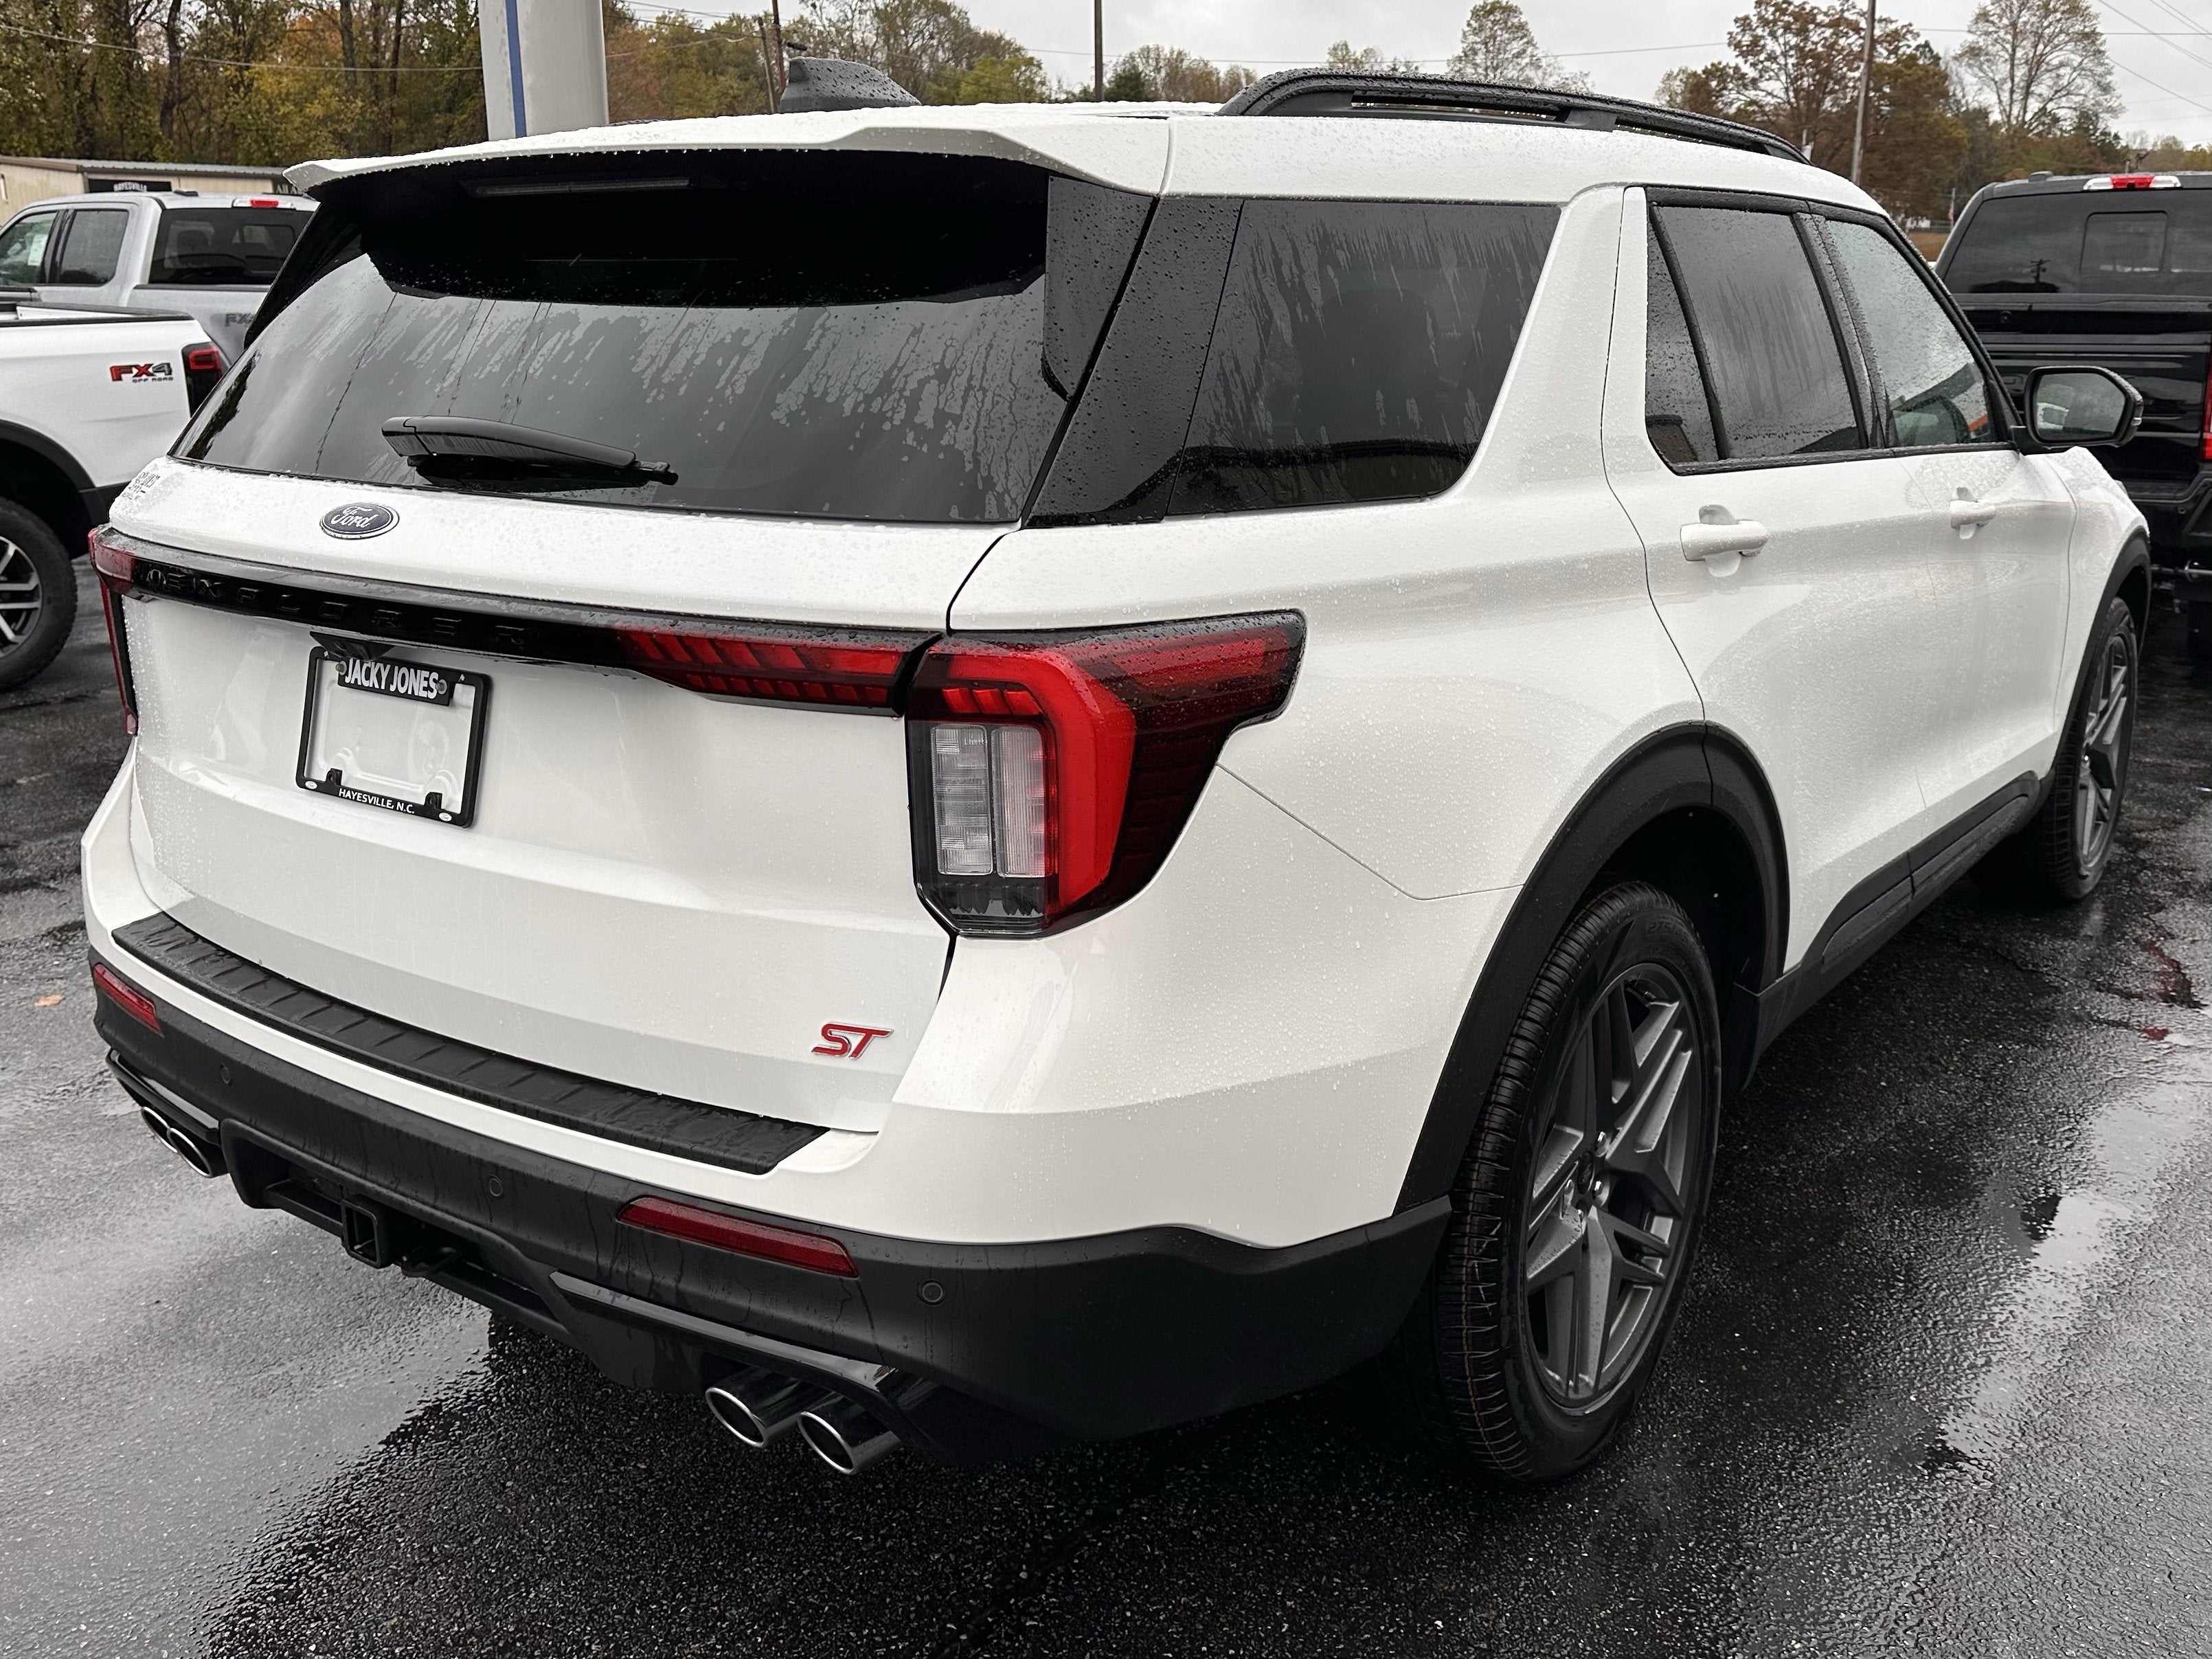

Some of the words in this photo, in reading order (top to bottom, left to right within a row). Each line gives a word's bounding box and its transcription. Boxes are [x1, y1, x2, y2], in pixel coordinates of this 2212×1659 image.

[110, 363, 172, 381] FX4
[331, 506, 379, 528] Ford
[344, 657, 391, 690] JACKY
[390, 666, 439, 699] JONES
[339, 788, 394, 809] HAYESVILLE,
[396, 801, 415, 814] N.C.
[811, 1022, 894, 1061] ST
